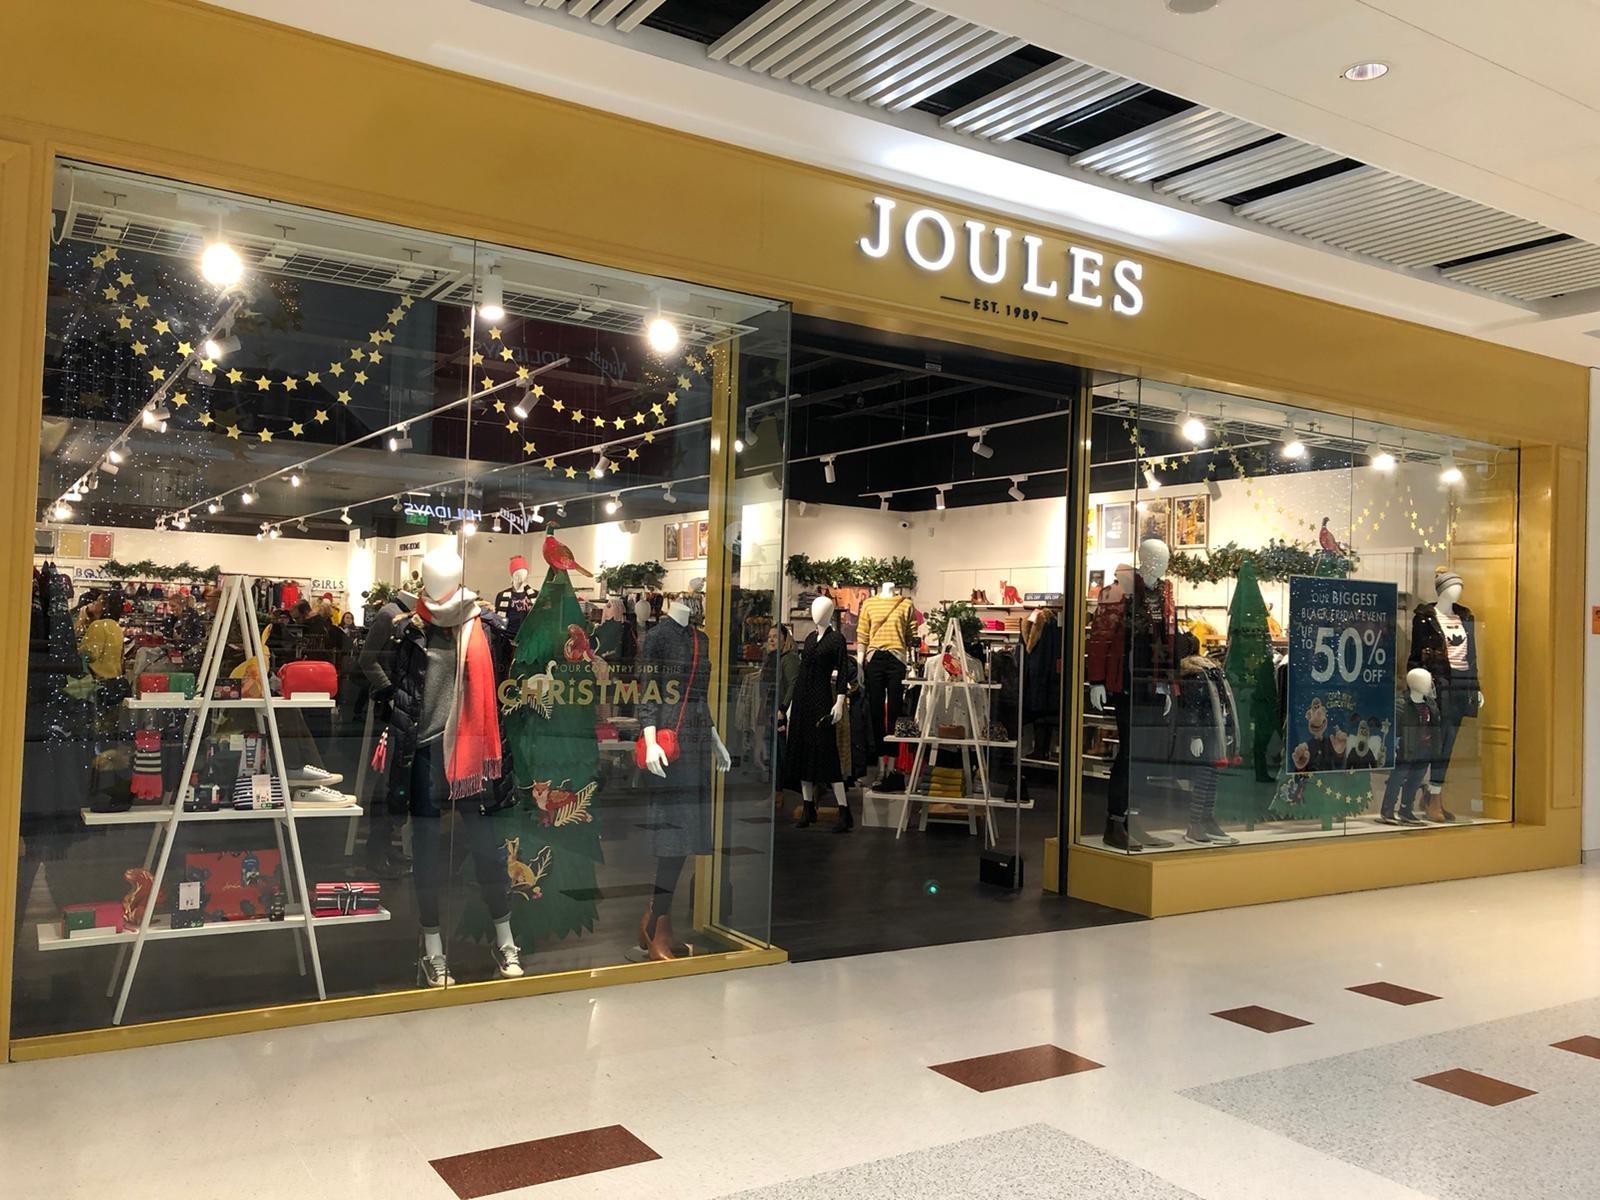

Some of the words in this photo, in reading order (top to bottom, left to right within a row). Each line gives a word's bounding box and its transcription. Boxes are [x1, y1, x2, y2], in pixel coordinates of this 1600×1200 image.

[857, 196, 1144, 317] JOULES
[974, 298, 999, 314] EST.
[1005, 304, 1038, 321] 1989
[76, 565, 112, 579] BOY
[312, 579, 344, 590] GIRLS
[1311, 592, 1330, 604] OUR
[1332, 591, 1378, 606] BIGGEST
[1330, 609, 1359, 621] FRIDAY
[1361, 611, 1387, 622] EVENT
[1302, 639, 1313, 650] TO
[1311, 627, 1386, 683] 50%
[584, 663, 633, 673] CONTRY
